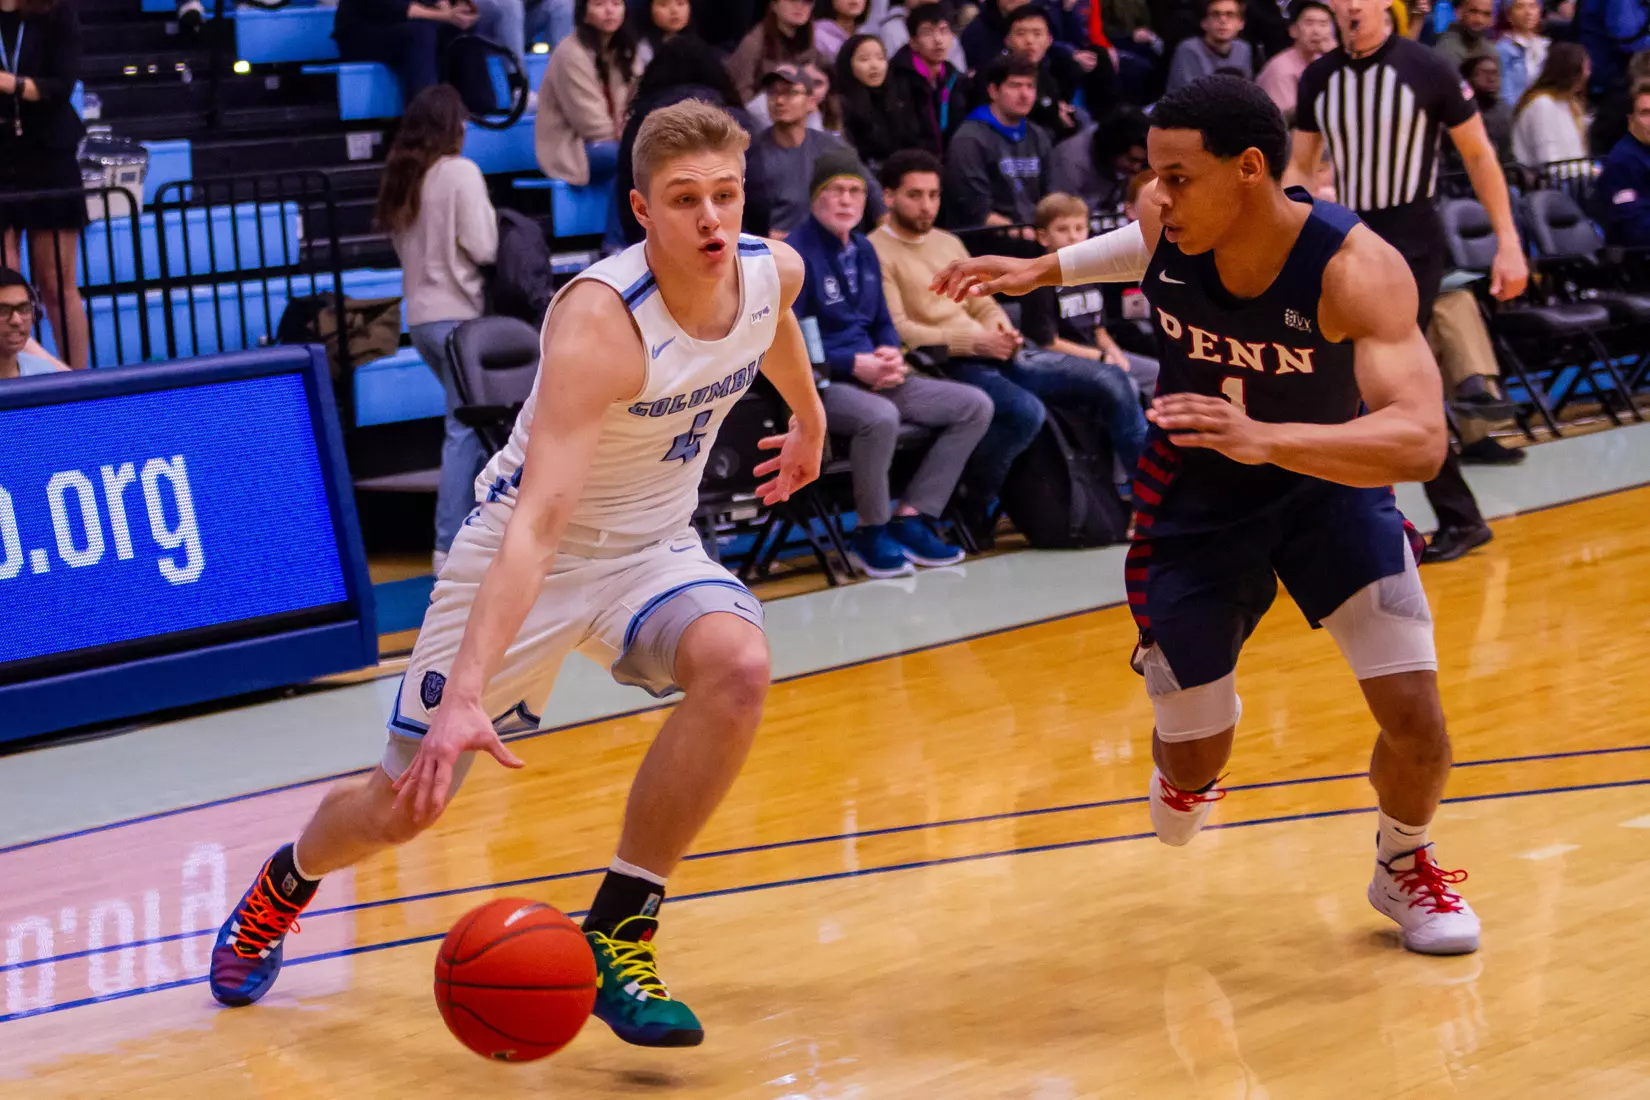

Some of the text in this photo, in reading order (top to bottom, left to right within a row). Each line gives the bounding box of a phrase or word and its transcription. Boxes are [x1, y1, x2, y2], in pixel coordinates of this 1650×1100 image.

[1156, 306, 1315, 375] PENN
[1220, 376, 1247, 416] 1
[661, 409, 713, 466] 4
